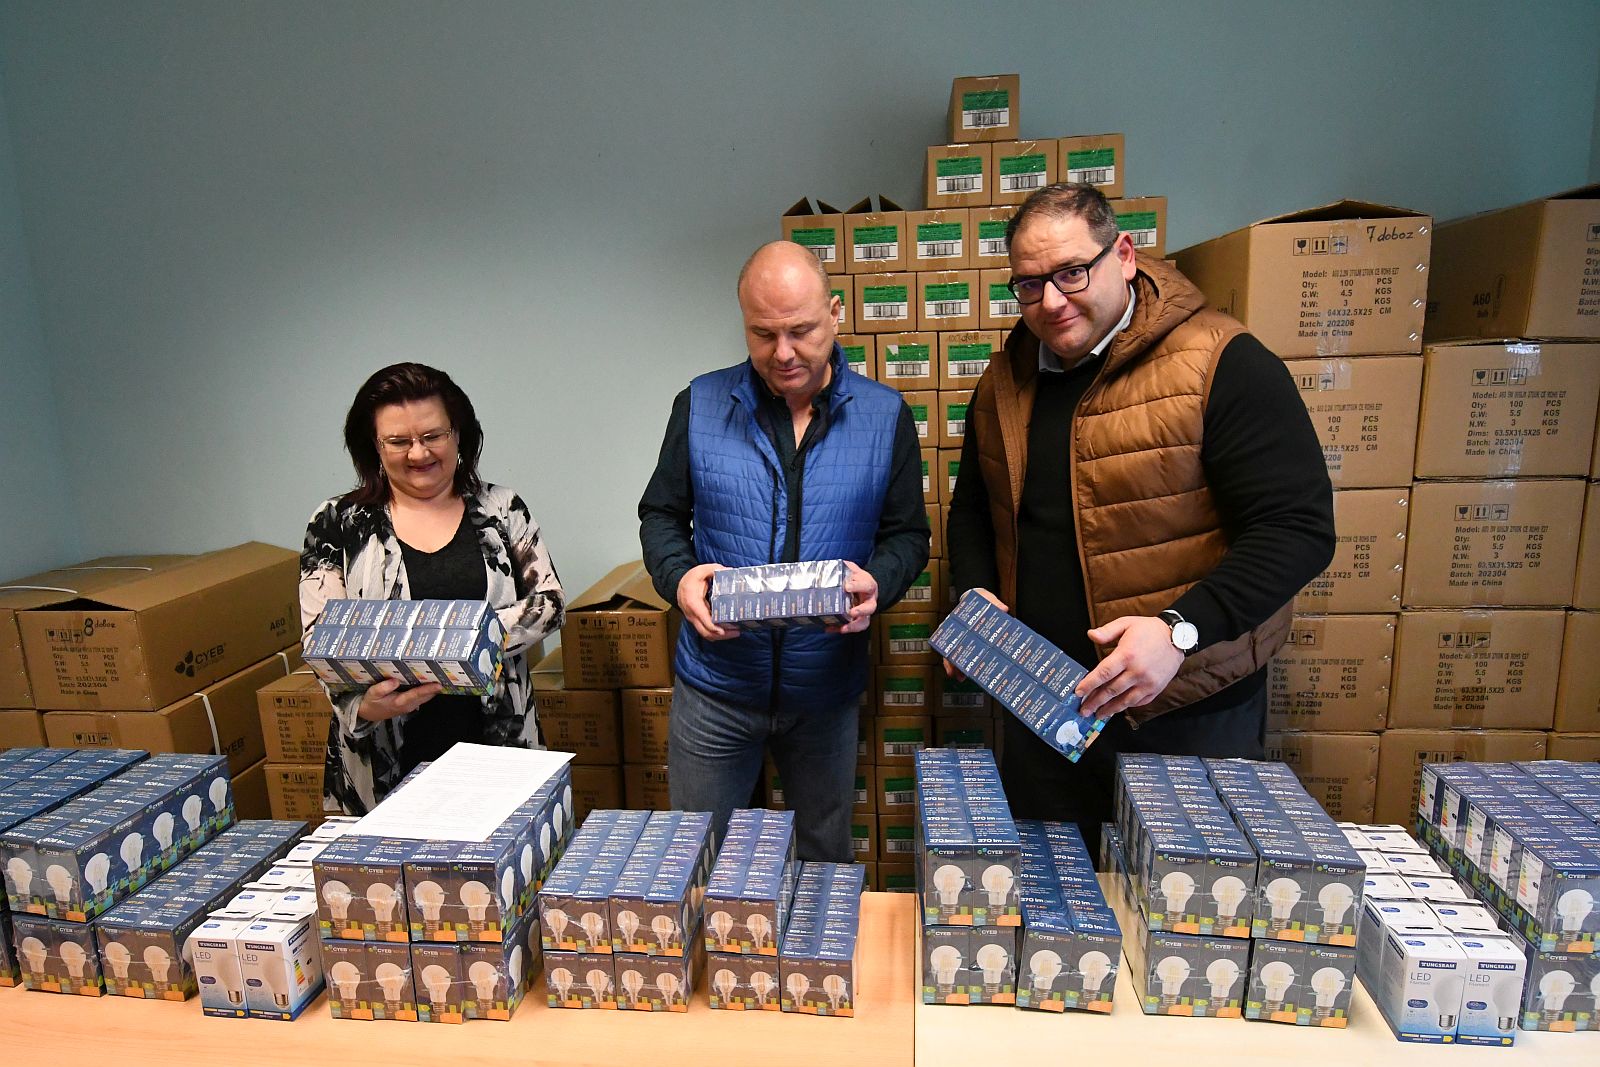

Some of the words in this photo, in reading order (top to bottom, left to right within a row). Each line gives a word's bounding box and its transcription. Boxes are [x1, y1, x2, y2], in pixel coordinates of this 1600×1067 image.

[1367, 226, 1376, 242] 7
[1377, 226, 1413, 241] doboz
[1586, 258, 1600, 266] Qty
[84, 618, 93, 636] 8
[196, 644, 225, 664] CYEB
[1012, 649, 1022, 660] 370
[1035, 667, 1046, 677] 370
[1060, 687, 1071, 698] 370
[1035, 719, 1047, 730] 370
[221, 737, 244, 754] YEB
[1410, 972, 1431, 980] LED
